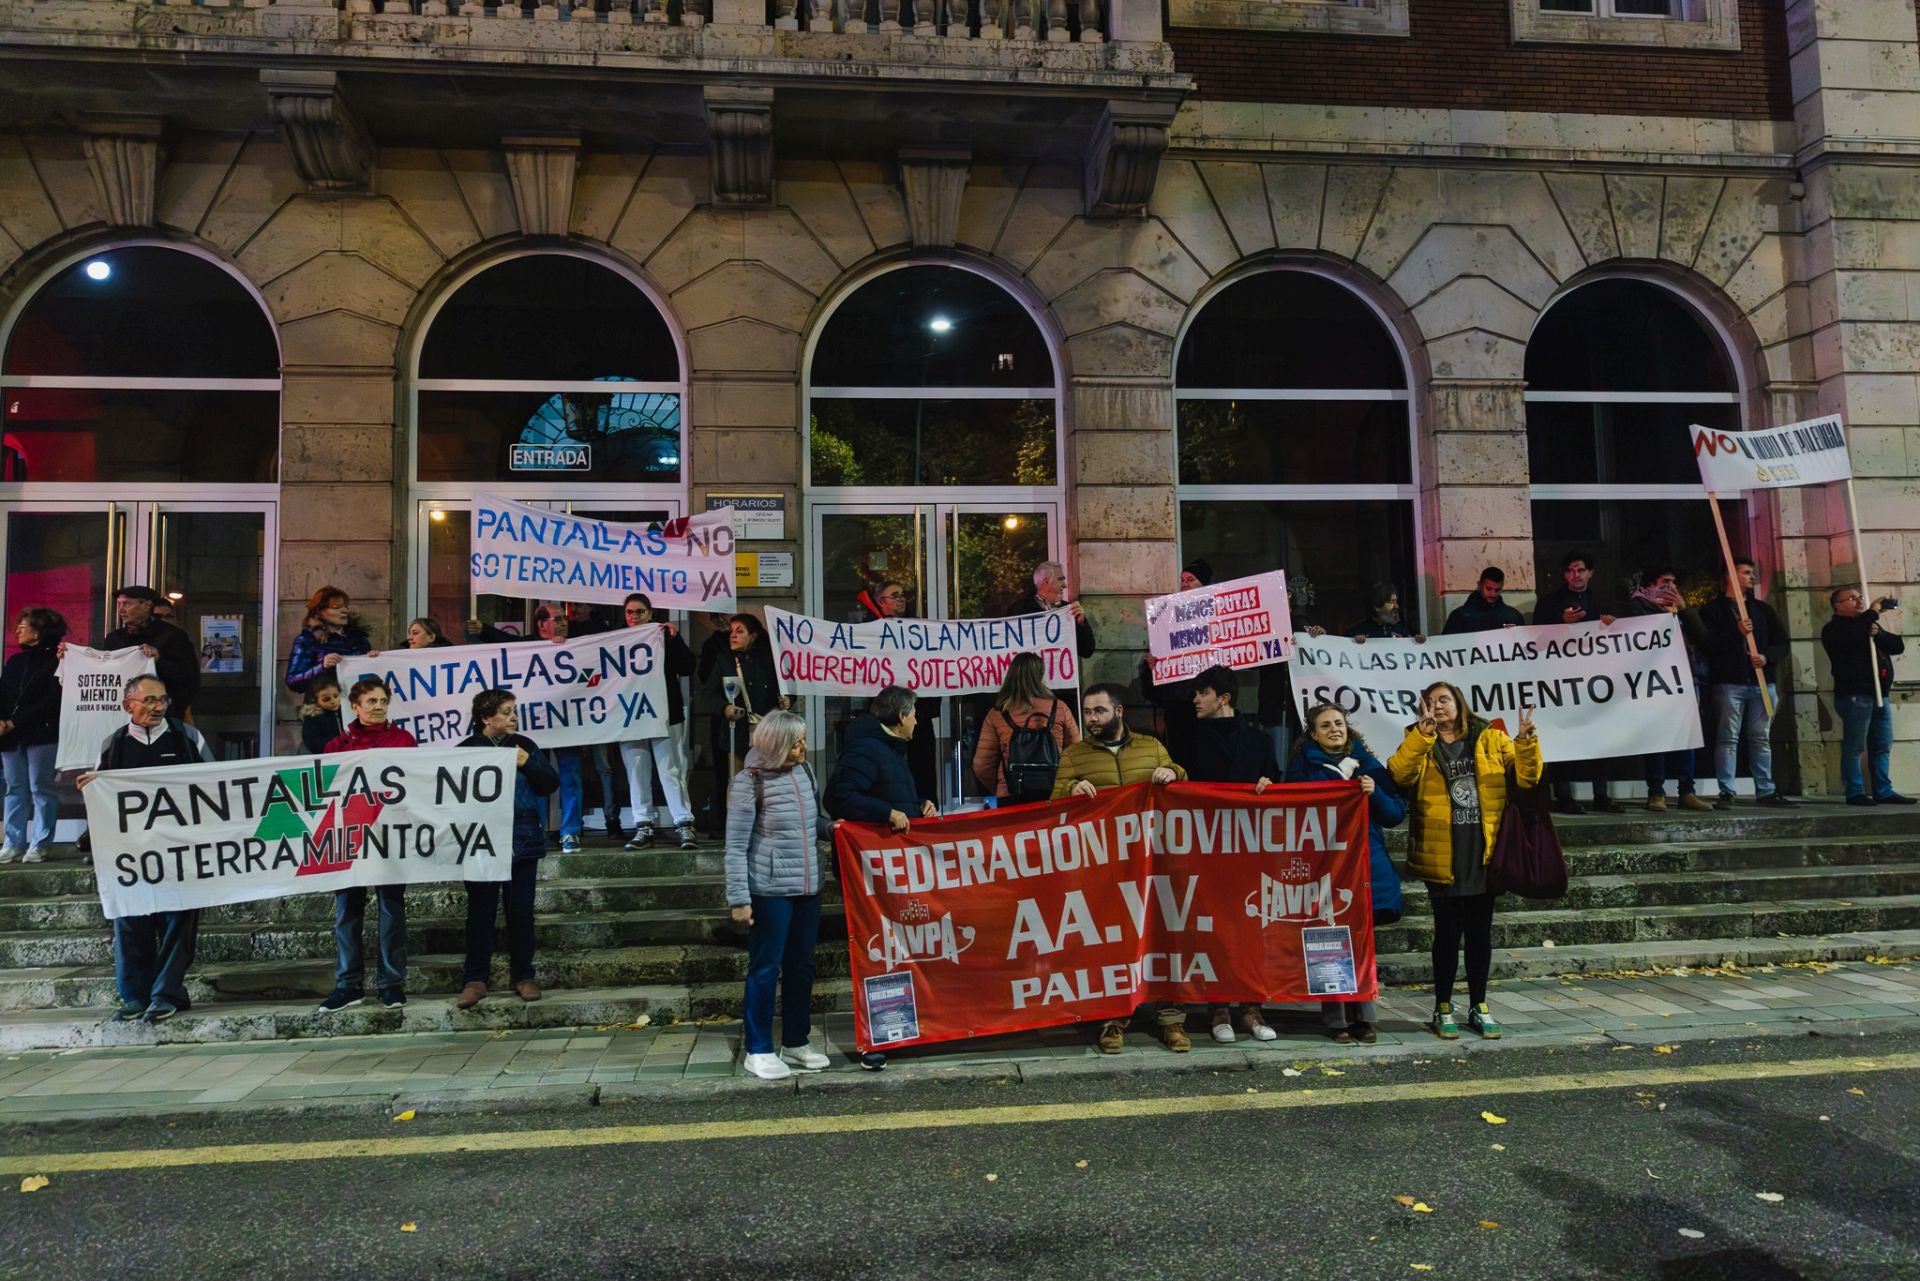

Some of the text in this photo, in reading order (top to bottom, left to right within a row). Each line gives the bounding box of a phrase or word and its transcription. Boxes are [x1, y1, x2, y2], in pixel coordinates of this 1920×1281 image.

[513, 450, 587, 466] ENTRADA
[1694, 430, 1737, 457] NO
[713, 499, 777, 508] HORARIOS
[477, 508, 734, 556] PANTALLAS NO
[471, 552, 732, 602] SOTERRAMIENTO YA
[1215, 589, 1258, 616] PUTAS
[776, 615, 813, 644] NO
[830, 623, 866, 650] AL
[1169, 613, 1269, 650] MENOS PUTADAS
[1299, 626, 1673, 671] NO A LAS PANTALLAS ACÚSTICAS
[599, 642, 653, 679] NO
[779, 650, 896, 689] QUEREMOS
[78, 674, 122, 688] SOTERRA
[80, 688, 118, 702] MIENTO
[1623, 664, 1684, 699] YA!
[101, 704, 121, 712] NUNCA
[617, 691, 657, 728] YA
[117, 759, 504, 834] PANTALLAS NO
[115, 821, 497, 887] SOTERRAMIENTO YA
[860, 806, 1347, 897] FEDERACIÓN PROVINCIAL
[1006, 873, 1214, 961] AA.VV.
[1261, 872, 1335, 928] FAVPA
[881, 912, 959, 973] FAVPA
[1012, 952, 1219, 1010] PALENCIA
